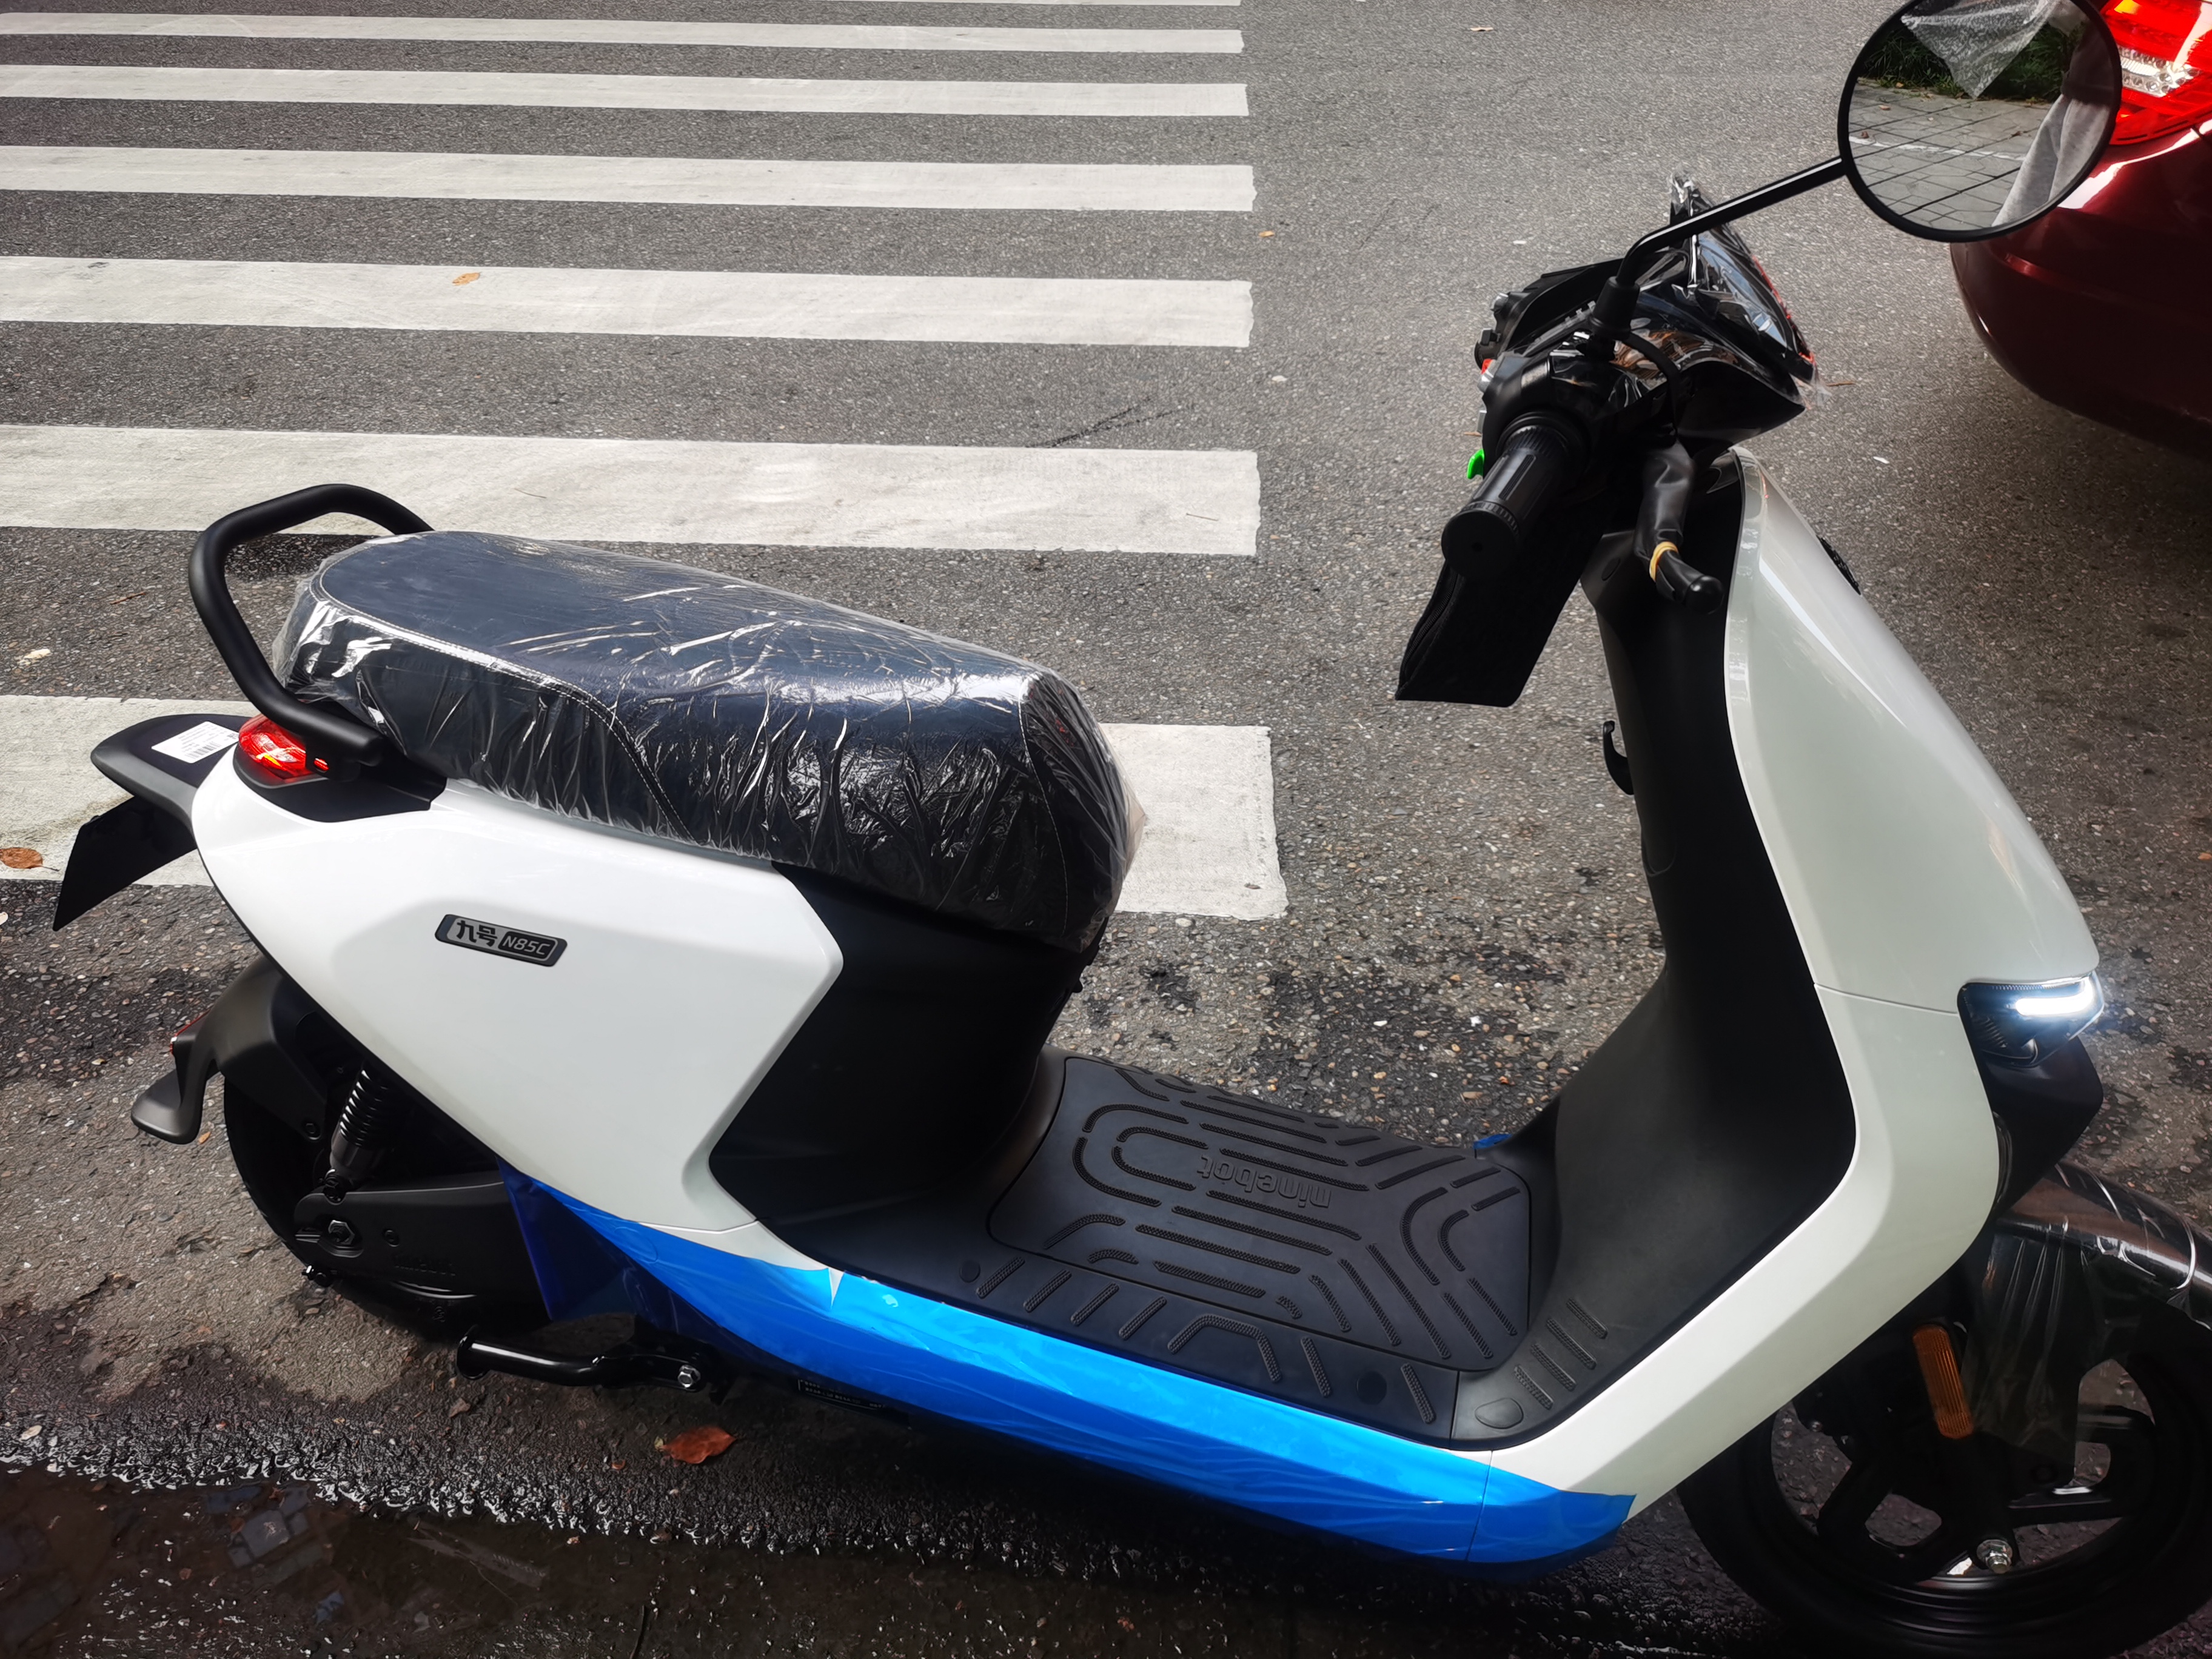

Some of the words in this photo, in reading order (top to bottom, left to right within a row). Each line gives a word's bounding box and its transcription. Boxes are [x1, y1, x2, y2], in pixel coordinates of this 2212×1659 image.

[456, 920, 498, 947] 九号
[503, 936, 551, 956] N85C
[1197, 1155, 1332, 1208] ninebot
